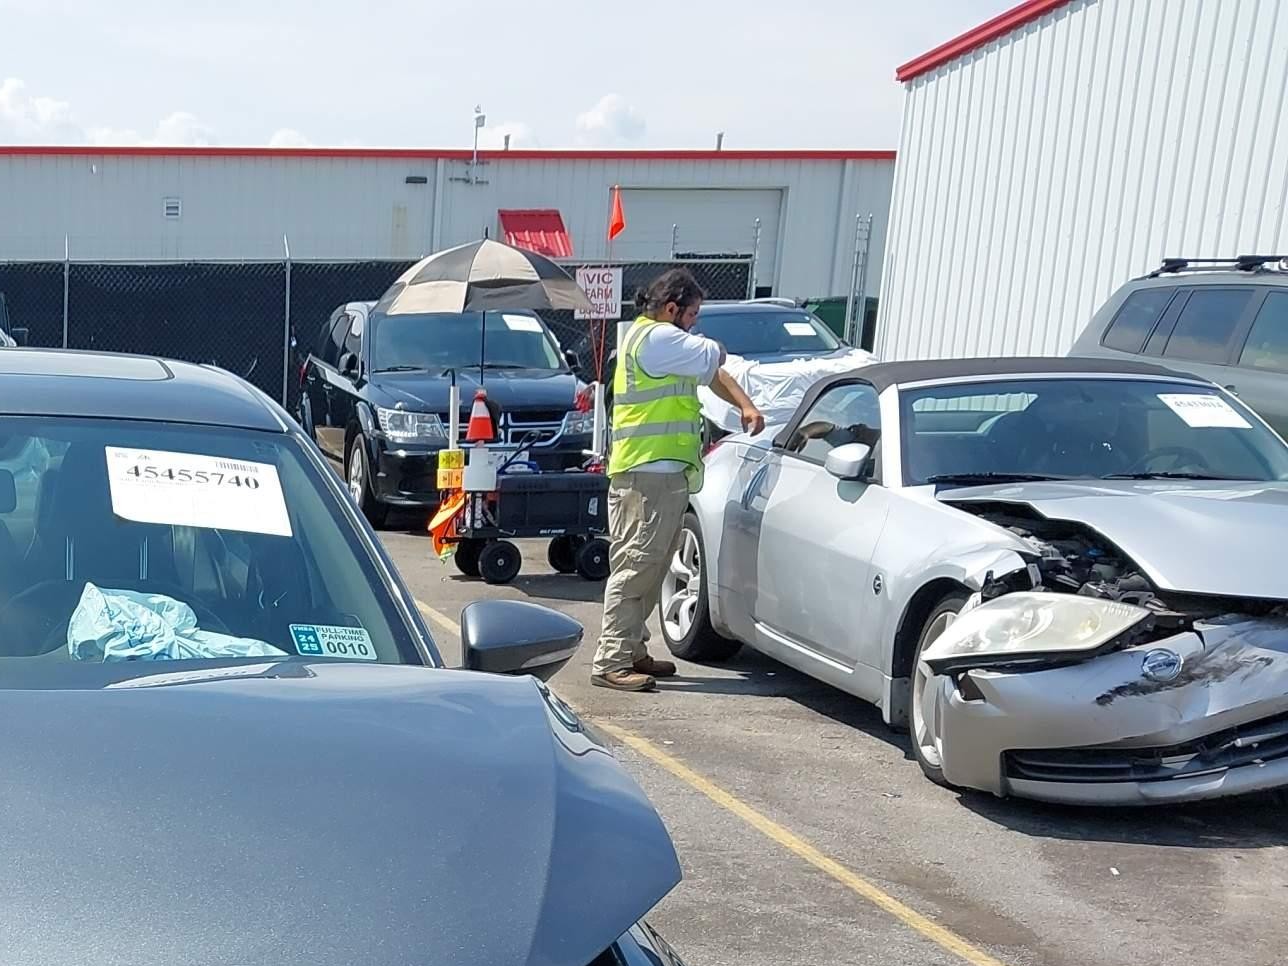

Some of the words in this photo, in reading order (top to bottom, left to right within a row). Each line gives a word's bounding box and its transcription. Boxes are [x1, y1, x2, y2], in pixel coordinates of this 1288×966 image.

[586, 273, 613, 284] VIC
[585, 288, 613, 300] FARM
[126, 464, 260, 489] 45455740
[326, 641, 369, 656] 0010
